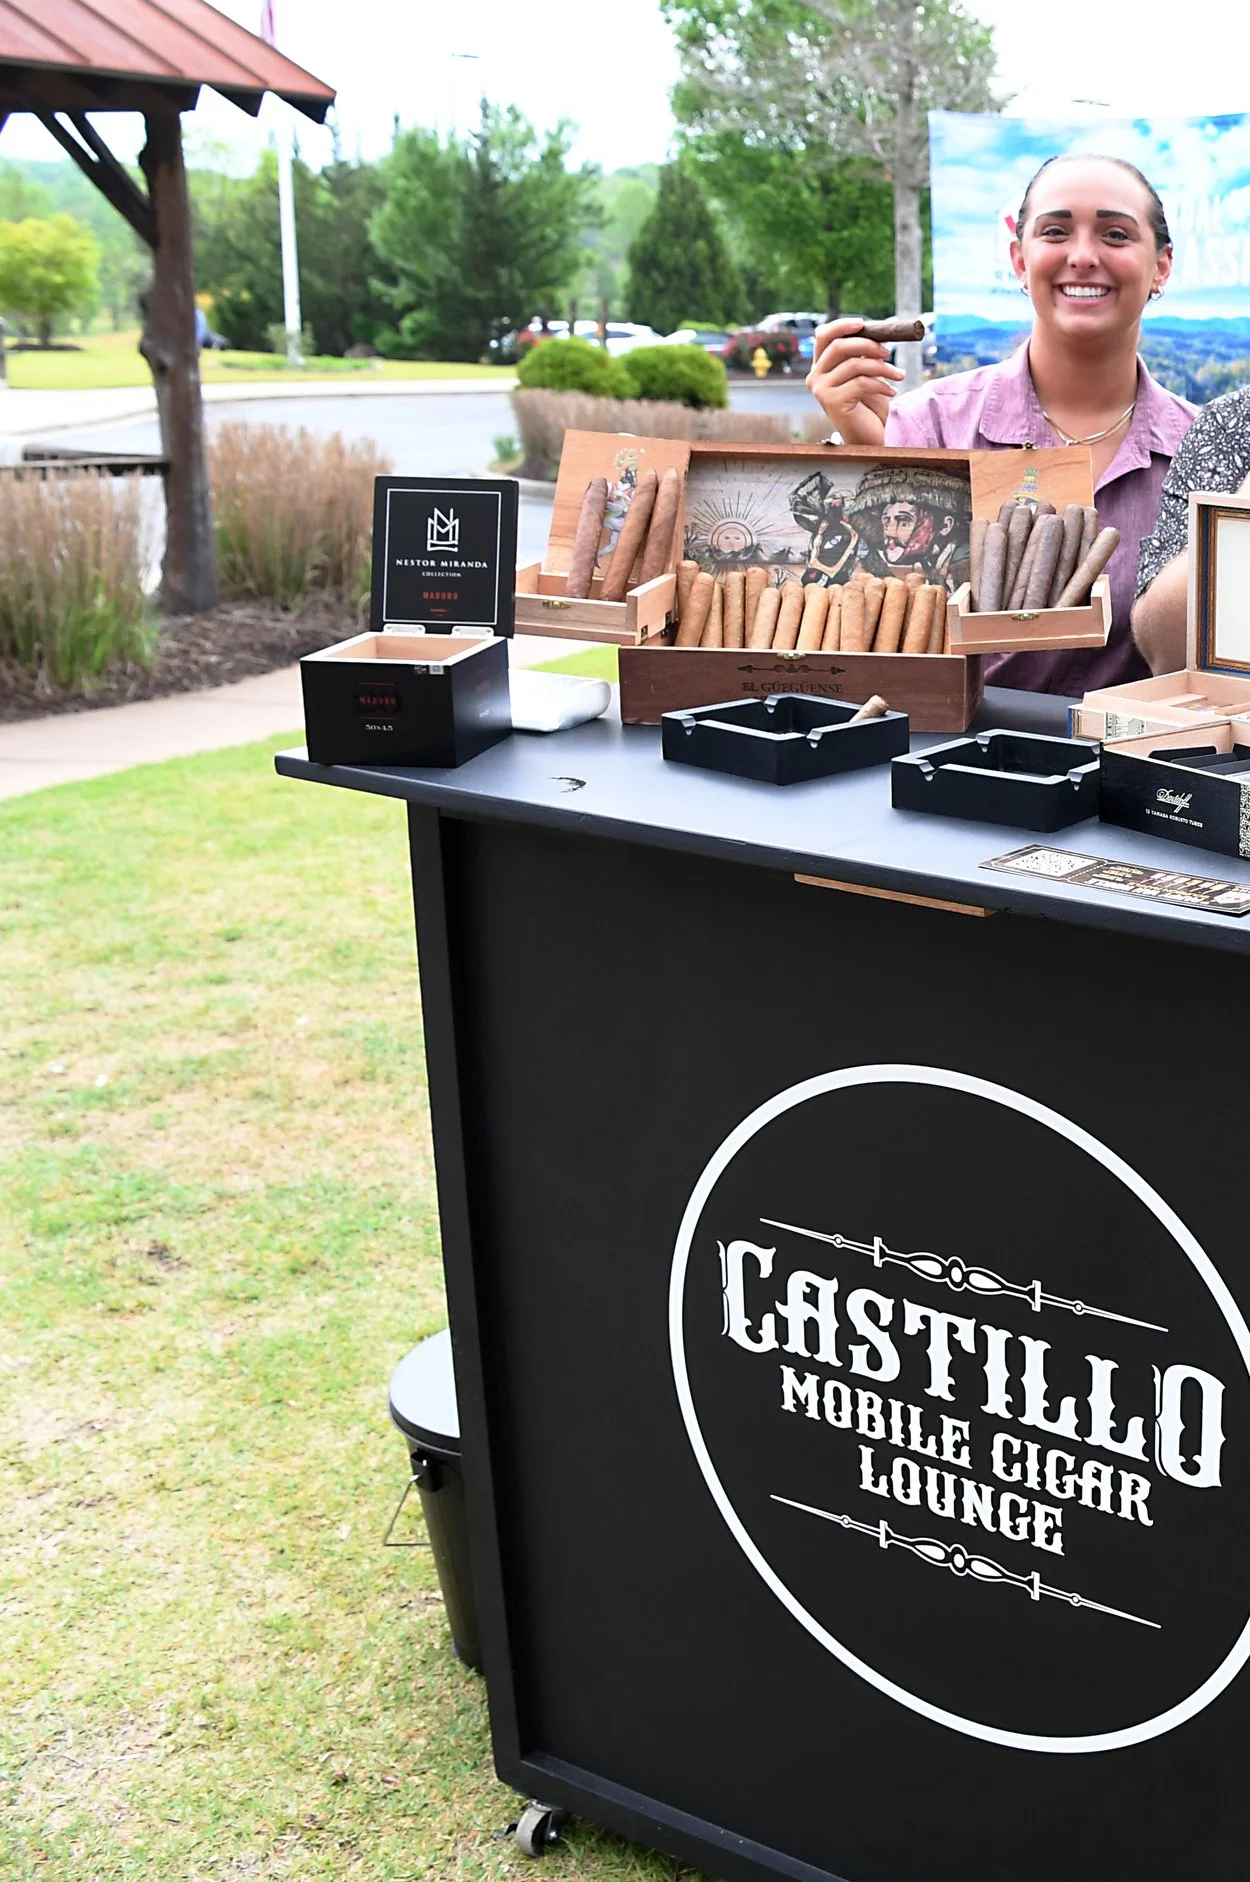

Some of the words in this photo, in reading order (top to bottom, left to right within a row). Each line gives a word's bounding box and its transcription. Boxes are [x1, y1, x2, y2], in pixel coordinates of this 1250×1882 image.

[395, 559, 437, 567] NESTOR
[440, 560, 489, 569] MIRANDA
[422, 592, 459, 600] MADURO
[742, 682, 759, 692] EL
[716, 1239, 1227, 1488] CASTILLO
[780, 1365, 972, 1470] MOBILE
[990, 1432, 1154, 1527] CIGAR
[858, 1445, 1065, 1556] LOUNGE
